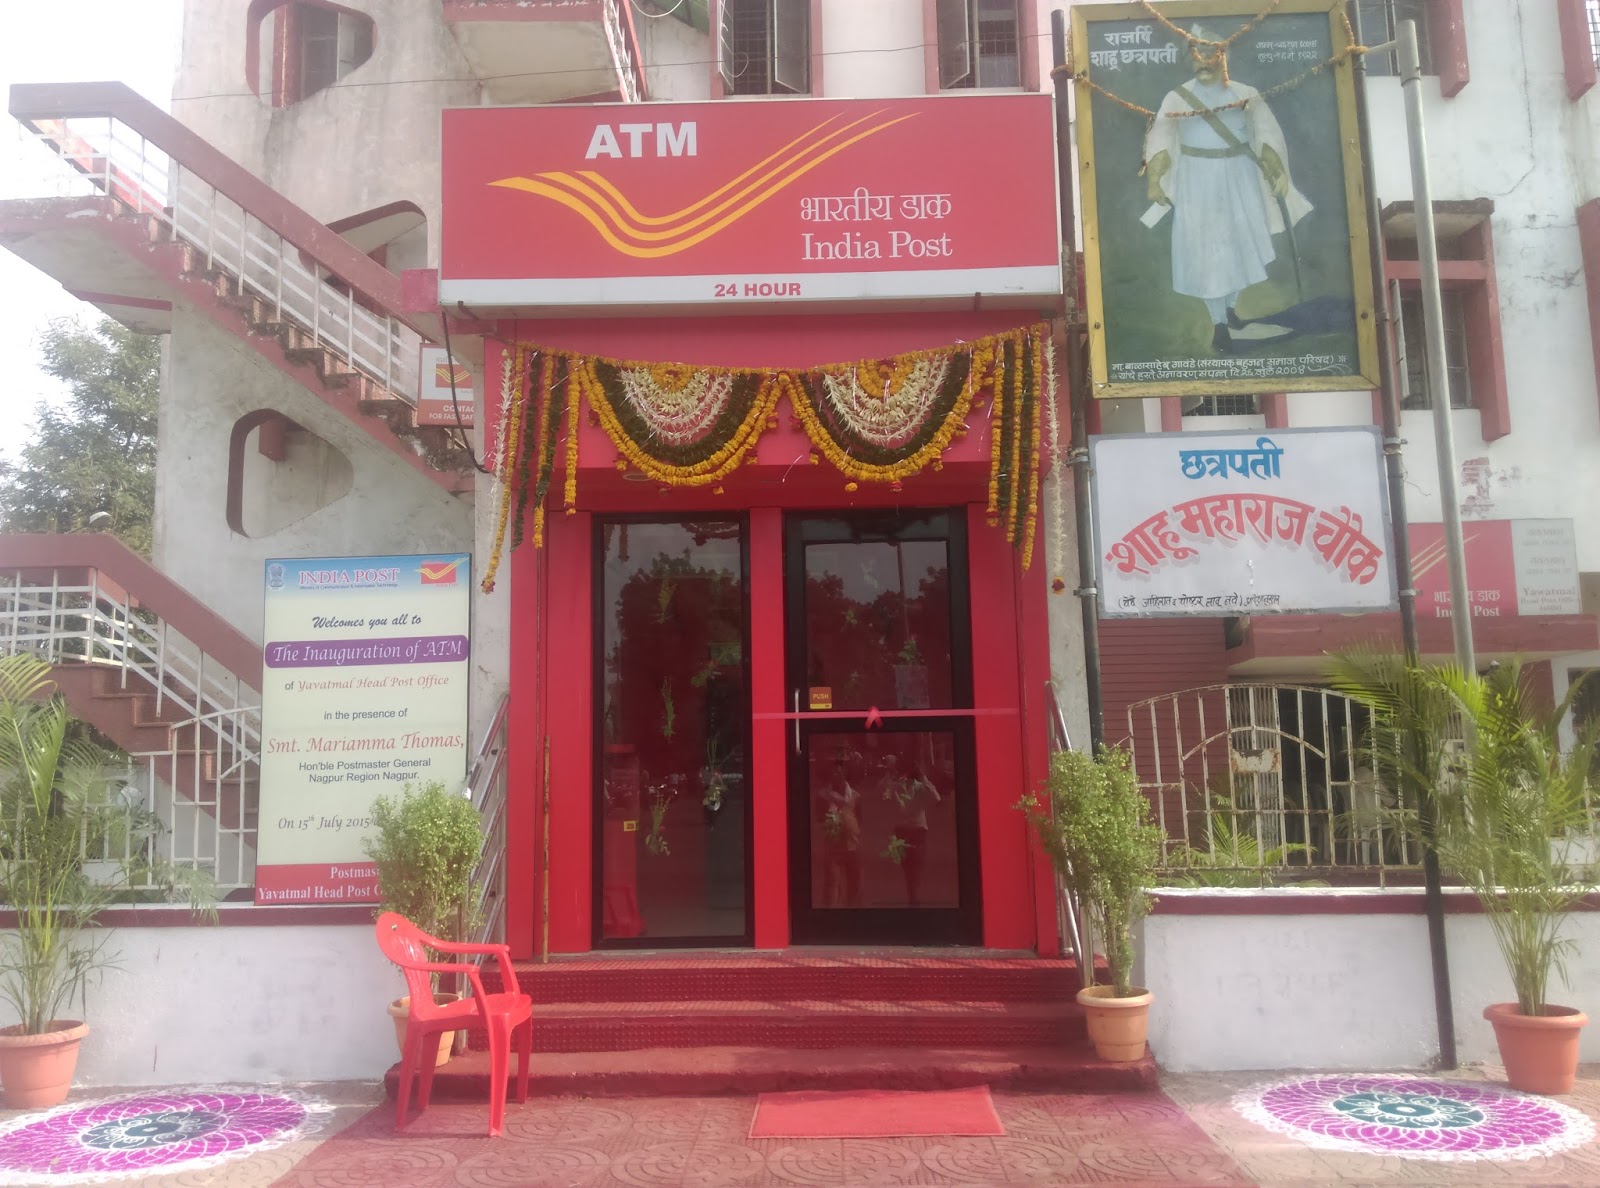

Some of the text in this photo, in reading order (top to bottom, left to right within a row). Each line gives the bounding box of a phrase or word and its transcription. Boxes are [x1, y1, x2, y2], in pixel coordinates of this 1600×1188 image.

[1104, 24, 1153, 46] राजर्षि
[1090, 43, 1179, 72] शाहू छत्रपती
[585, 121, 699, 160] ATM
[800, 186, 952, 223] भारतीय डाक
[801, 230, 953, 261] India Post
[714, 281, 802, 298] 24 HOUR
[1266, 357, 1297, 367] समाज
[1179, 437, 1284, 480] छत्रपती
[1105, 492, 1384, 585] शाहू महाराज चौक
[299, 568, 400, 585] INDIA POST
[1476, 590, 1501, 602] डाक
[1474, 606, 1501, 618] Post
[312, 613, 422, 630] Welcomes you all to
[273, 640, 462, 665] The Inauguration of ATM
[285, 675, 450, 692] of Yavatmal Head Post Office
[324, 708, 408, 722] in the presence of
[267, 731, 465, 754] Smt. Mariamma Thomas,
[299, 758, 431, 771] Hon'ble Postmaster General
[309, 771, 420, 785] Nagpur Region Nagpur.
[278, 817, 294, 830] On
[298, 814, 315, 831] 15th
[317, 815, 343, 832] July
[258, 885, 311, 901] Yavatmal
[314, 884, 344, 899] Head
[347, 884, 371, 898] Post
